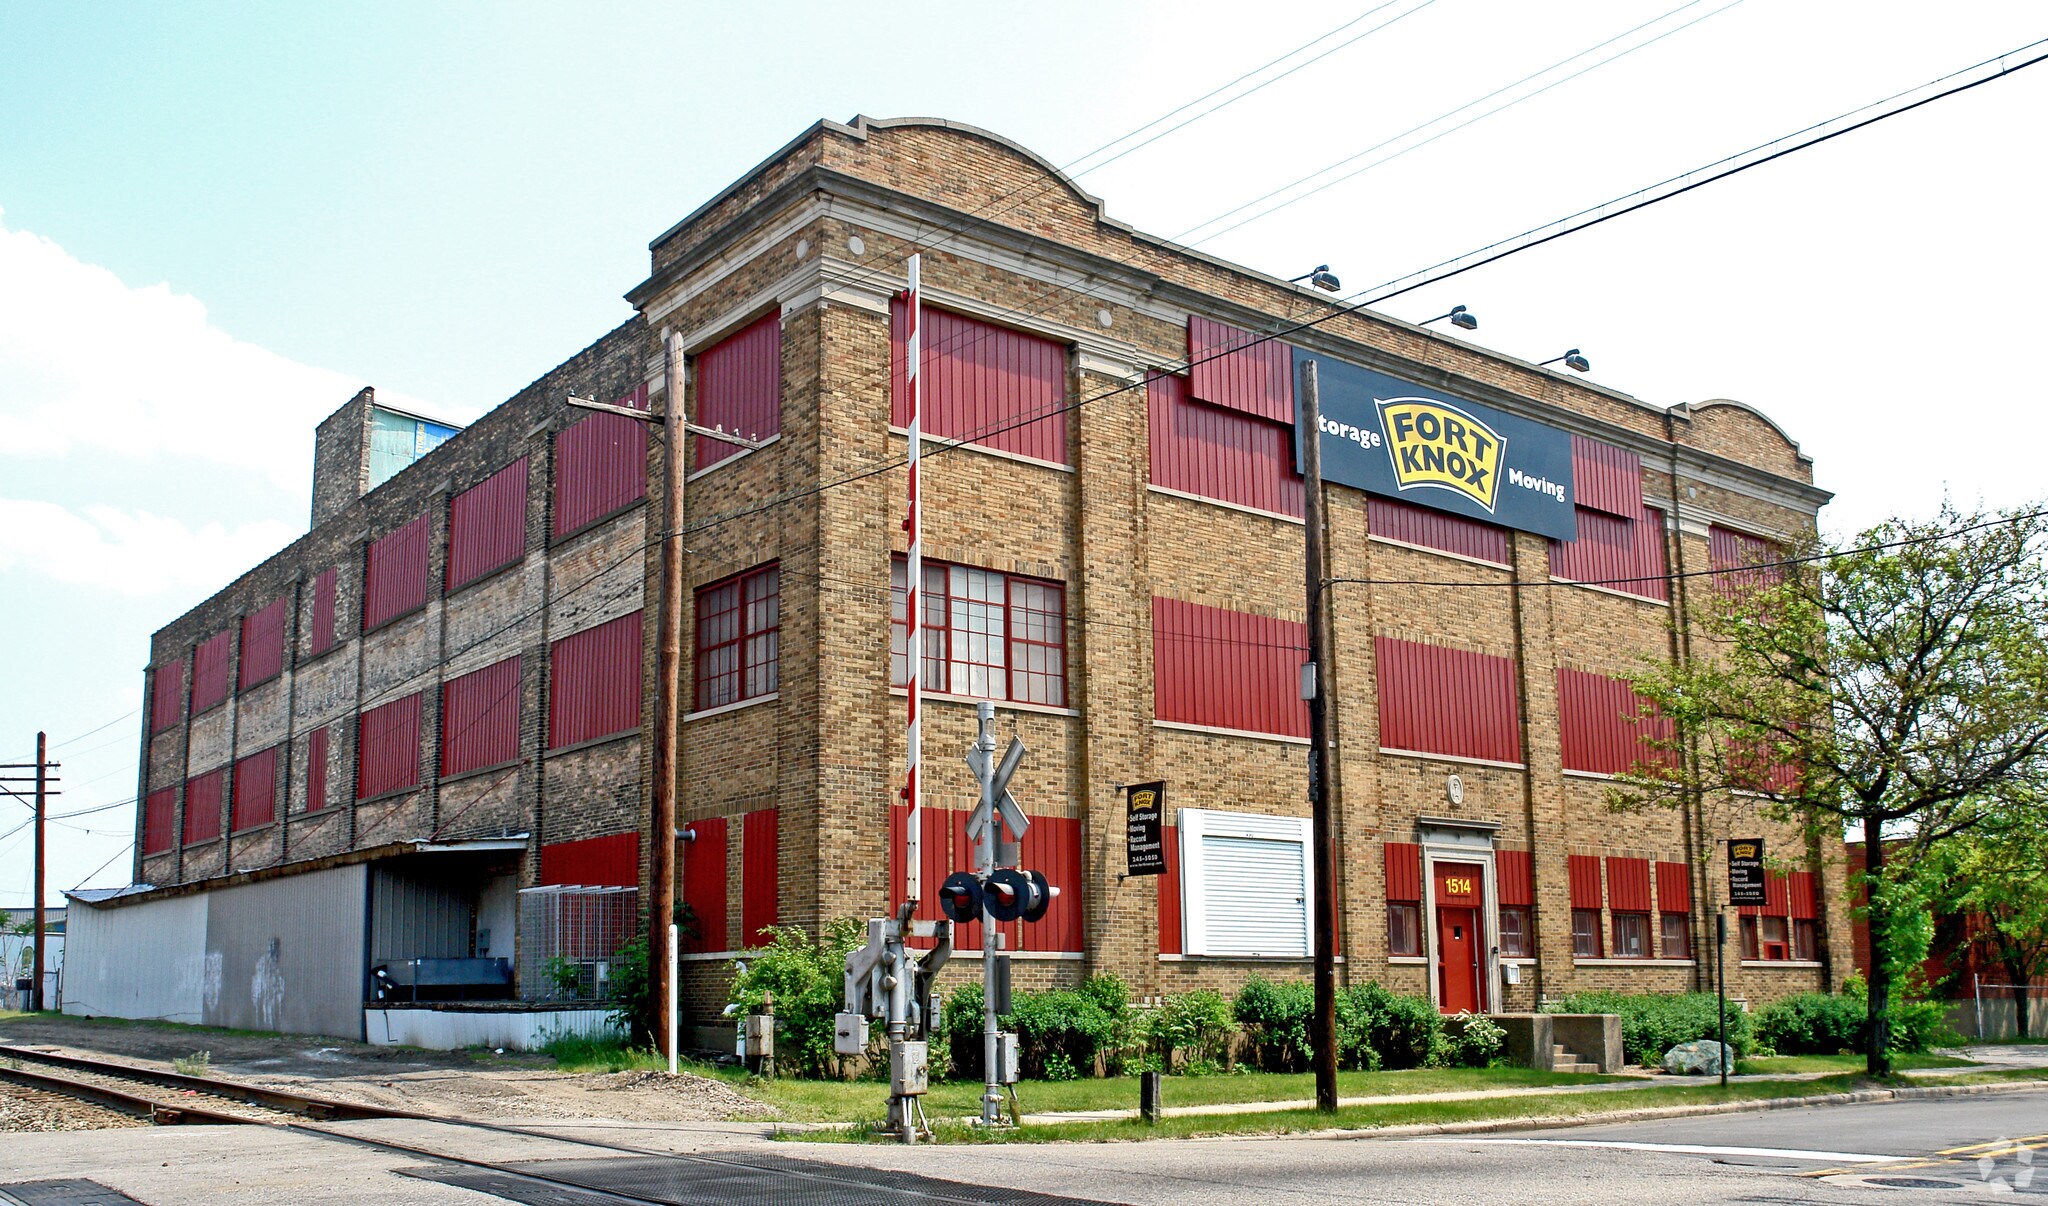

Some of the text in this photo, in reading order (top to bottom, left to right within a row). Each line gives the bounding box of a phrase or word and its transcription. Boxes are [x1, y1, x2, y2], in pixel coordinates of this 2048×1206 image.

[1318, 413, 1381, 450] torage
[1392, 412, 1492, 462] FORT
[1400, 444, 1490, 494] KNOX
[1508, 467, 1565, 503] Moving
[1134, 793, 1152, 802] FORT
[1134, 799, 1151, 808] KNOX
[1129, 812, 1157, 822] Self Storage
[1130, 824, 1146, 833] Moving
[1130, 835, 1146, 843] Record
[1130, 842, 1160, 852] Management
[1446, 878, 1471, 893] 1514
